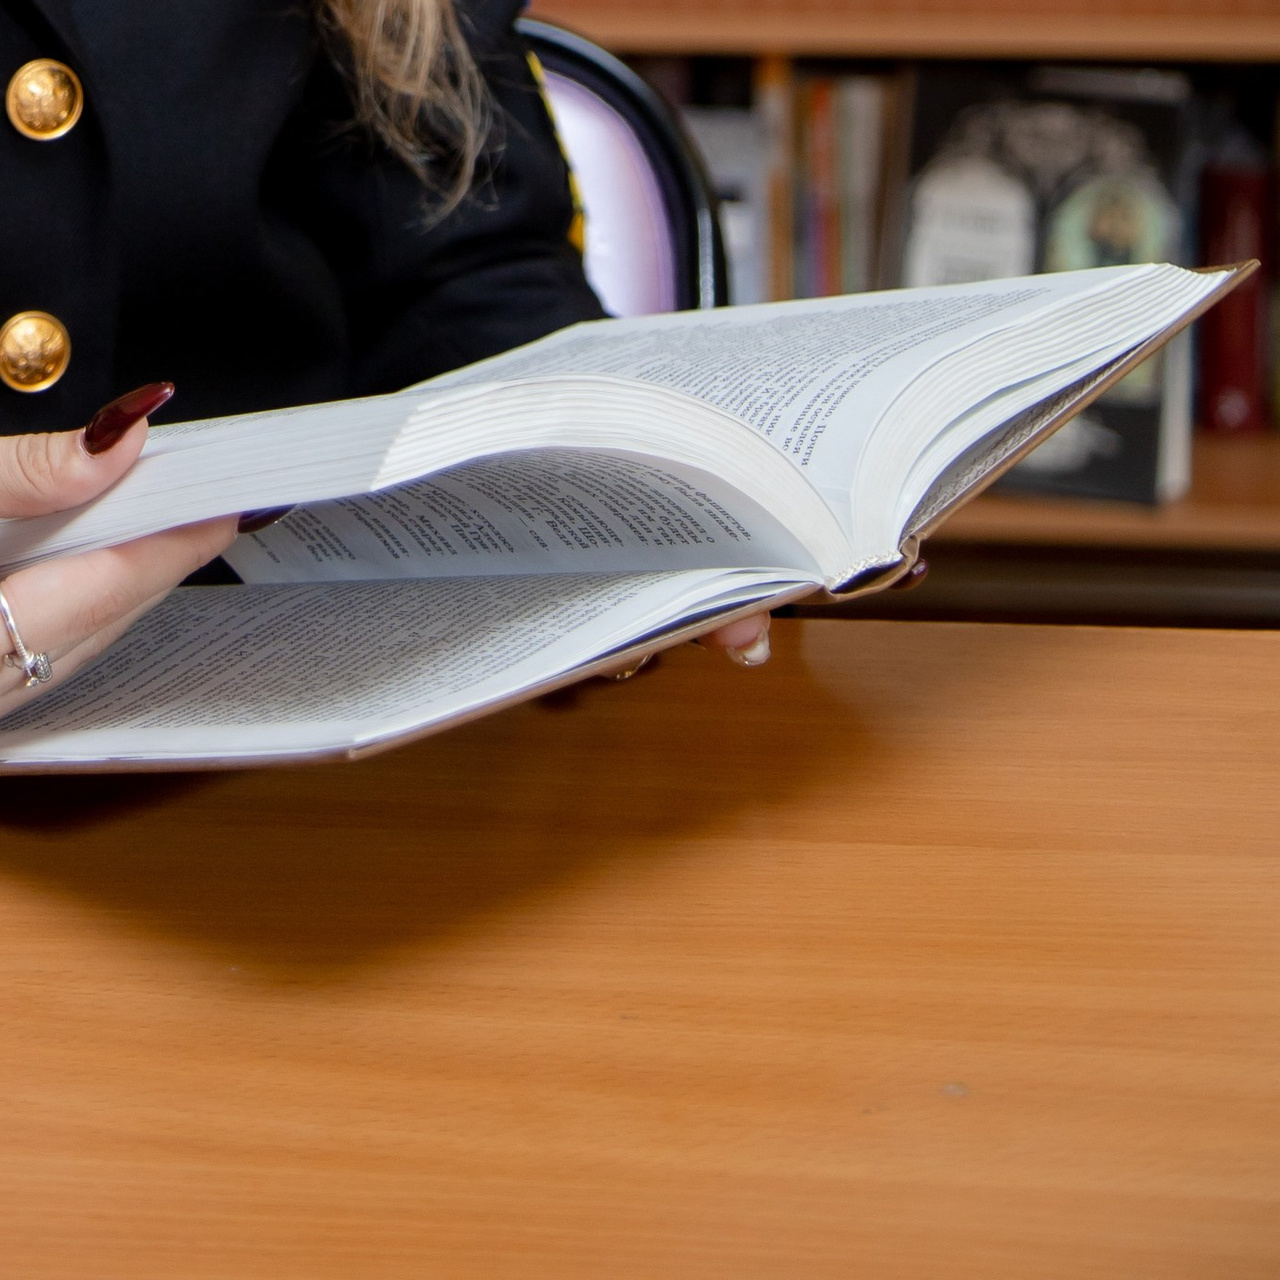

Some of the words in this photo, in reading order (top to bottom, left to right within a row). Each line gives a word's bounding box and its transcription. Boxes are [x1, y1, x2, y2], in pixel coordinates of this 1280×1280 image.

[793, 407, 822, 454] остался
[801, 424, 827, 466] Почти
[599, 499, 649, 546] современ-
[650, 488, 707, 535] заговорил
[659, 515, 690, 545] будет
[695, 491, 751, 541] фашистов.
[704, 508, 739, 542] знаме-
[577, 526, 599, 548] Шо-
[656, 526, 676, 546] так
[674, 518, 703, 544] годы
